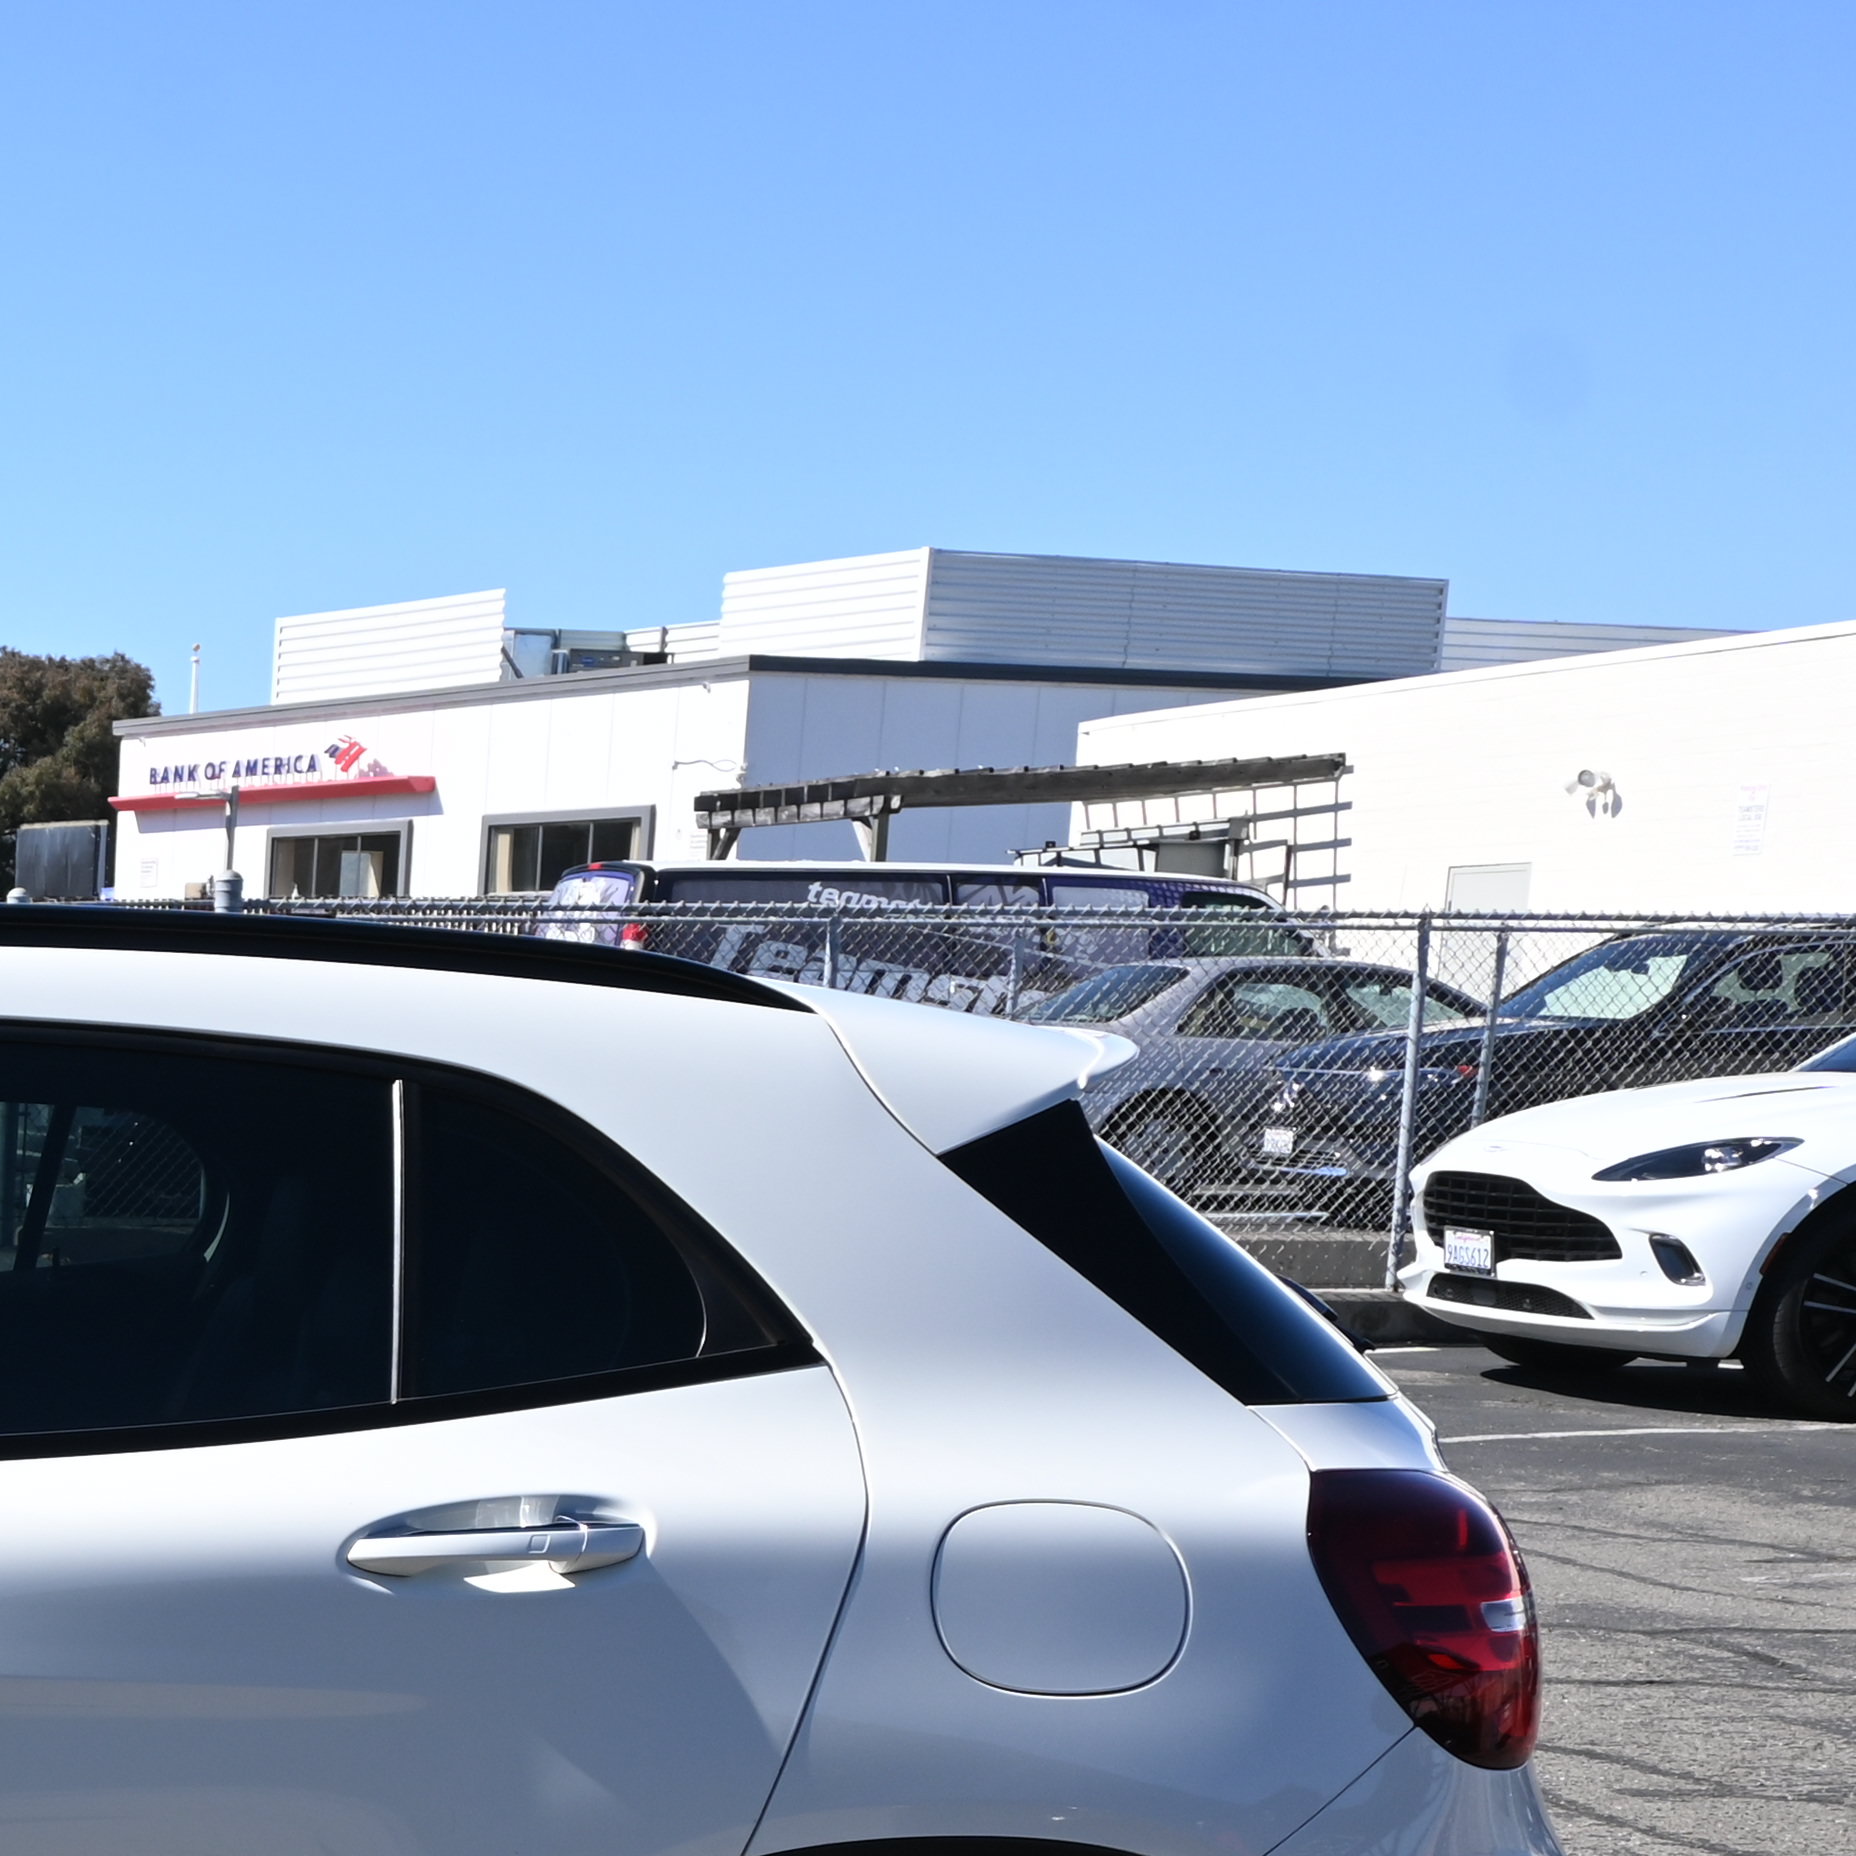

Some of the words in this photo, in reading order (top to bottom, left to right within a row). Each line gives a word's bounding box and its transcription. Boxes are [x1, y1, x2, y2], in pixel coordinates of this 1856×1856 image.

[149, 763, 199, 785] BANK
[204, 761, 227, 780] OF
[231, 754, 318, 778] AMERICA
